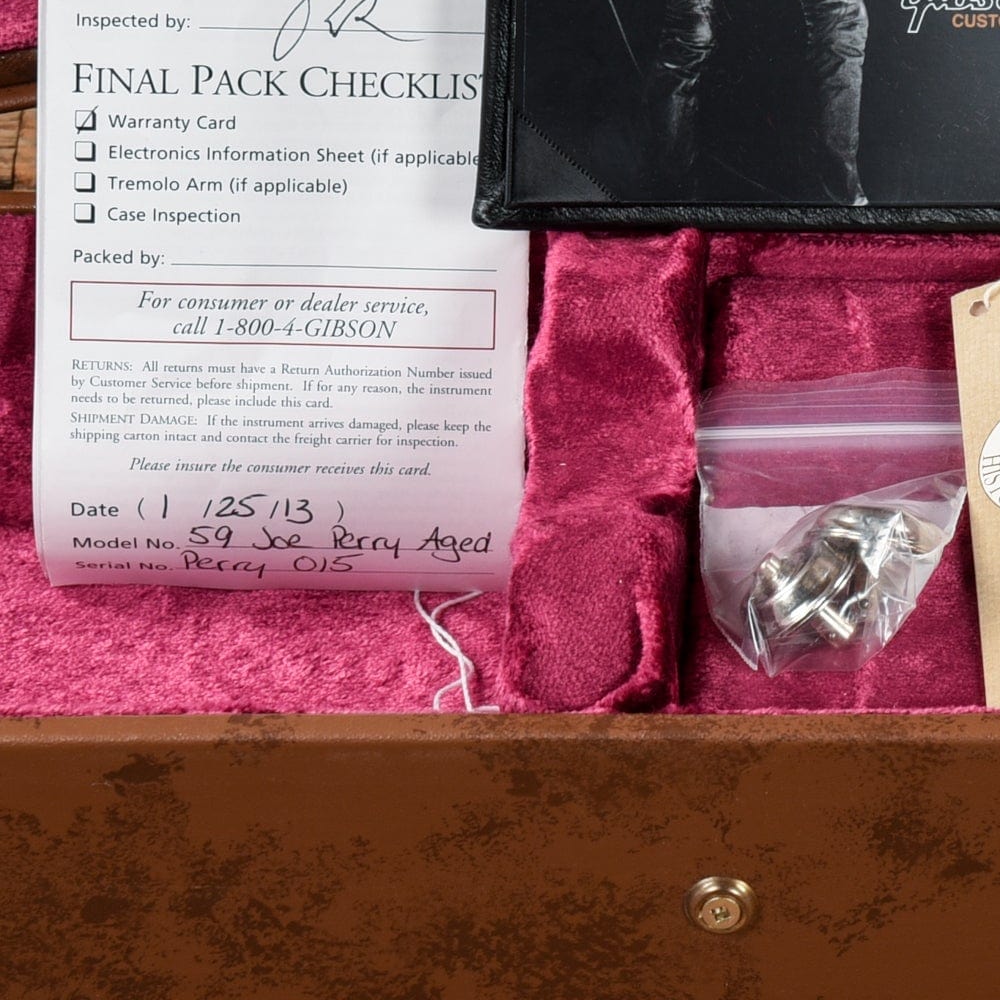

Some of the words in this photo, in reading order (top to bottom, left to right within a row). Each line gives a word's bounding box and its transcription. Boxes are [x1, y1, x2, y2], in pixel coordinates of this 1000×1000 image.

[76, 12, 159, 31] Inspected
[165, 13, 191, 33] by:
[300, 67, 483, 100] CHECKLIS
[108, 114, 191, 133] Warranty
[196, 115, 236, 130] Card
[109, 145, 201, 161] Electronics
[207, 146, 310, 163] Information
[317, 148, 365, 164] Sheet
[371, 148, 389, 166] (if
[107, 175, 180, 192] Tremolo
[185, 177, 223, 192] Arm
[229, 177, 248, 195] (if
[253, 177, 348, 196] applicable)
[107, 206, 146, 222] Case
[153, 207, 241, 226] Inspection
[73, 249, 134, 265] Packed
[140, 249, 165, 269] by:
[137, 290, 172, 309] For
[177, 297, 269, 311] consumer
[273, 299, 295, 311] or
[300, 291, 359, 313] dealer
[363, 301, 429, 317] service,
[172, 315, 209, 336] call
[215, 317, 398, 339] 1-800-4-GIBSON
[142, 360, 159, 372] All
[163, 364, 204, 373] returns
[207, 365, 236, 374] must
[240, 361, 266, 374] have
[269, 366, 277, 375] a
[281, 363, 320, 376] Return
[324, 364, 402, 378] Authorization
[407, 366, 456, 379] Number
[459, 367, 493, 380] issued
[129, 456, 171, 472] Please
[175, 458, 217, 472] insure
[221, 458, 243, 473] the
[246, 464, 312, 474] consumer
[315, 462, 366, 475] receives
[369, 461, 395, 476] this
[398, 461, 432, 476] card.
[71, 502, 119, 518] Date
[73, 537, 137, 550] Model
[146, 538, 181, 550] No.
[75, 561, 132, 570] Serial
[139, 561, 173, 571] No.
